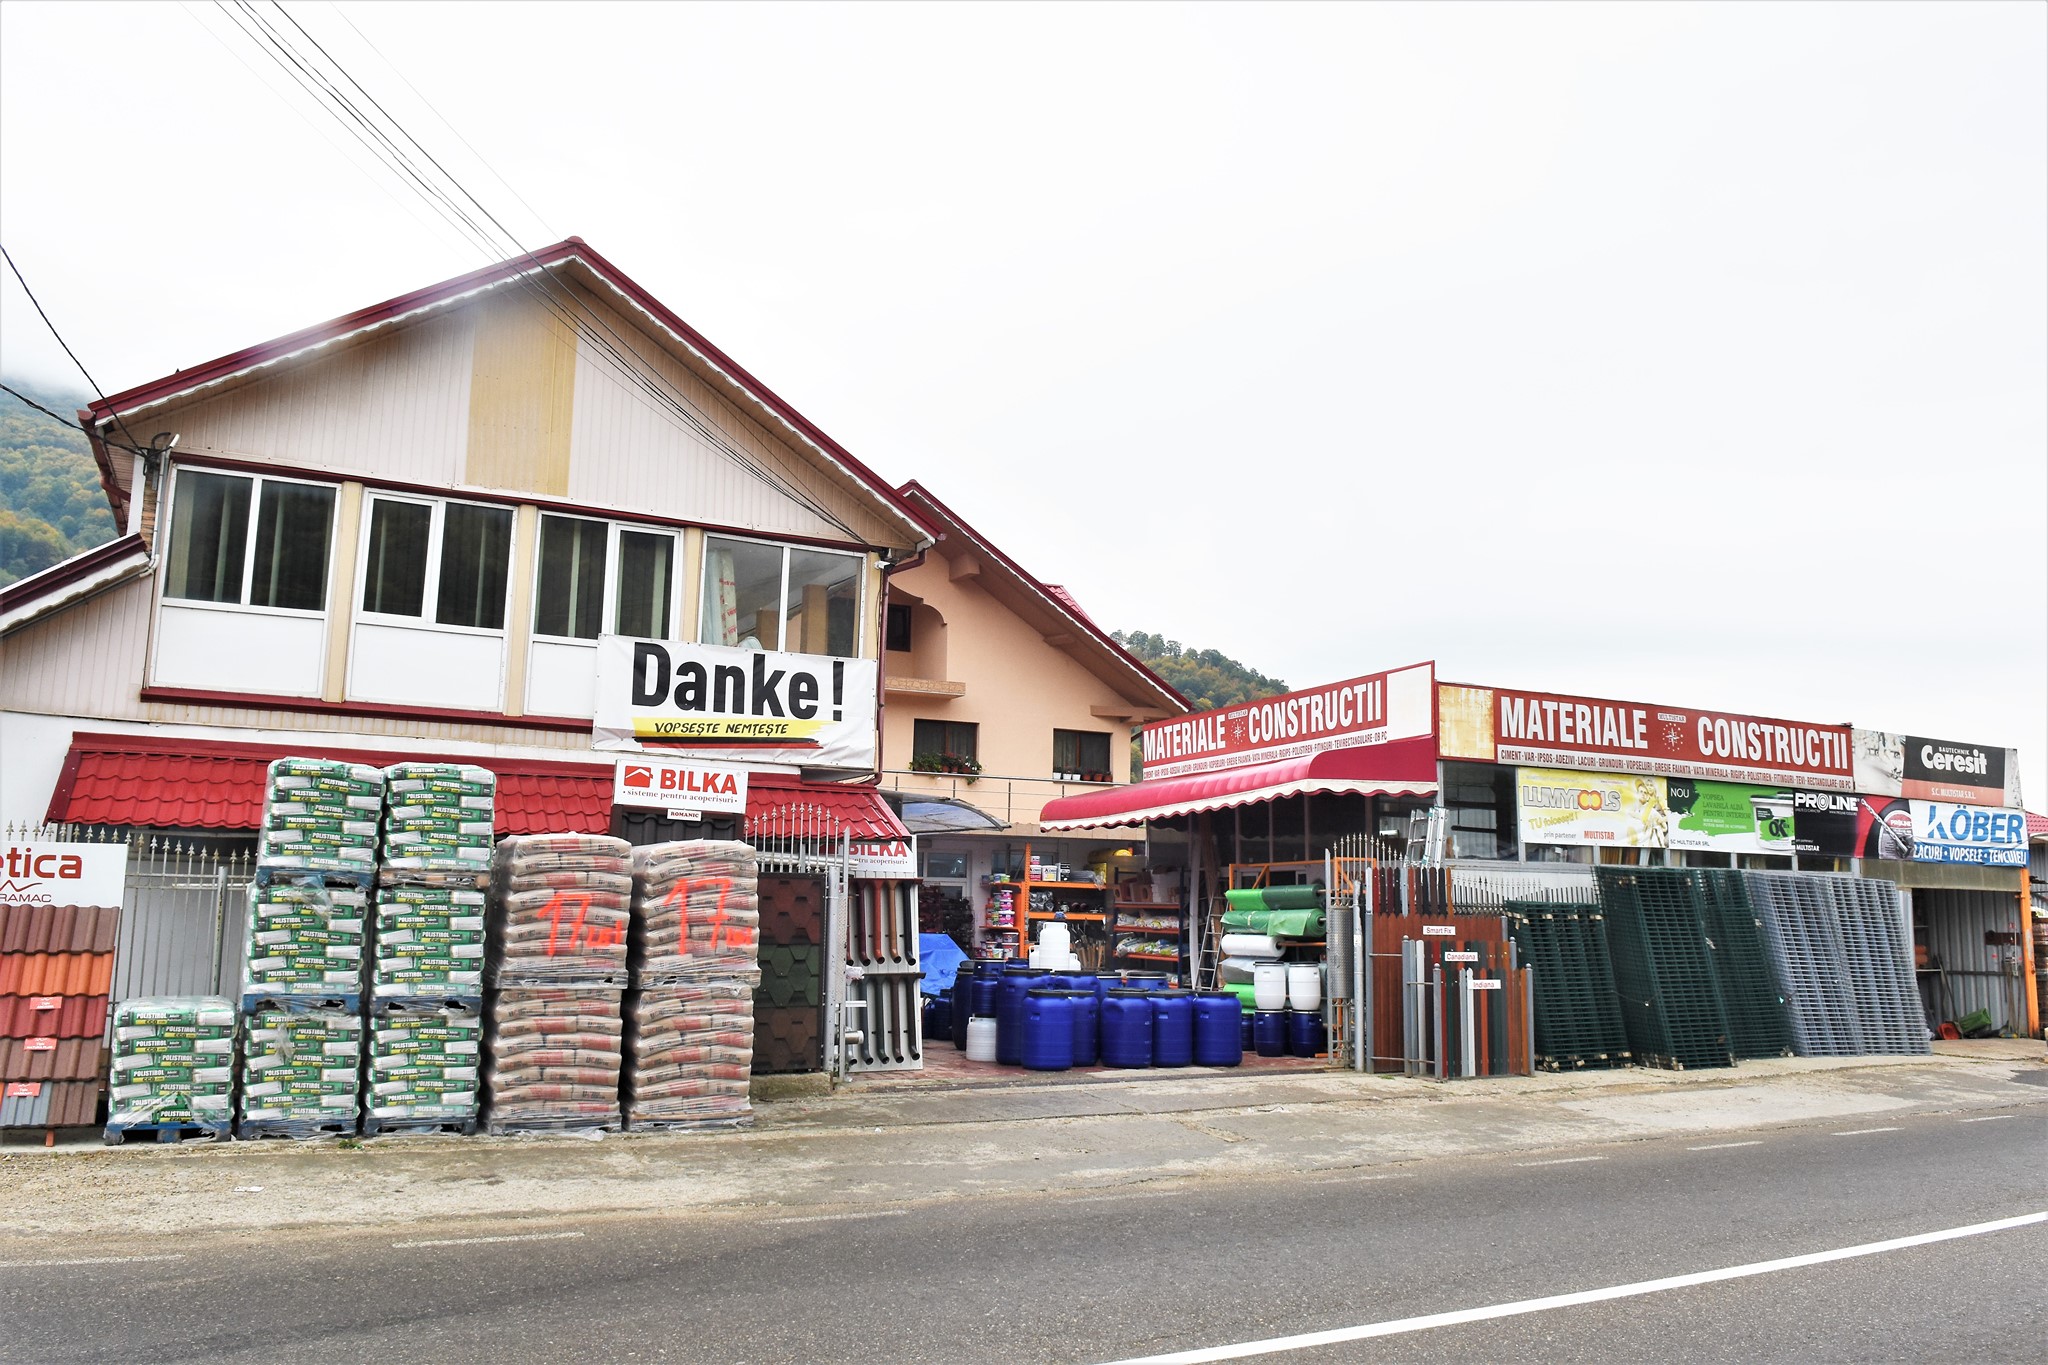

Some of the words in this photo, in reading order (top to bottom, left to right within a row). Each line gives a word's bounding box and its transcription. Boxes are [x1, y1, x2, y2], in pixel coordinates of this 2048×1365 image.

[1248, 680, 1382, 743] CONSTRUCTII
[1501, 696, 1648, 749] MATERIALE
[1144, 714, 1226, 762] MATERIALE
[1698, 716, 1848, 769] CONSTRUCTII
[1939, 747, 1970, 755] BAUTECHNIK
[1501, 750, 1521, 761] CIMENT
[1524, 752, 1535, 761] VAR
[1538, 753, 1552, 763] IPSOS
[1556, 754, 1575, 765] ADEZIVI
[1578, 756, 1596, 767] LACURI
[1599, 758, 1623, 769] GRUNDURI
[1626, 760, 1652, 771] VOPSELURI
[1655, 763, 1671, 772] GRESIE
[1672, 764, 1691, 774] FAIANTA
[1693, 766, 1704, 775] VATA
[1706, 768, 1728, 777] MINERALA
[1730, 770, 1745, 779] RIGIPS
[1747, 771, 1772, 782] POLISTIREN
[1807, 777, 1837, 787] RECTANGULARE
[1846, 781, 1851, 789] PC
[1921, 745, 1987, 774] Ceresit
[627, 789, 658, 798] sisteme
[660, 792, 687, 800] pentru
[660, 769, 737, 795] BILKA
[1670, 788, 1689, 798] NOU
[1523, 786, 1620, 811] LUMYTOOLS
[1795, 793, 1858, 811] PROLINE
[1528, 818, 1542, 829] TU
[1584, 831, 1614, 840] MULTISTAR
[1928, 805, 2023, 844] KÖBER
[1914, 844, 1942, 859] LACURI
[1950, 846, 1983, 863] VOPSELE
[664, 878, 732, 955] 17
